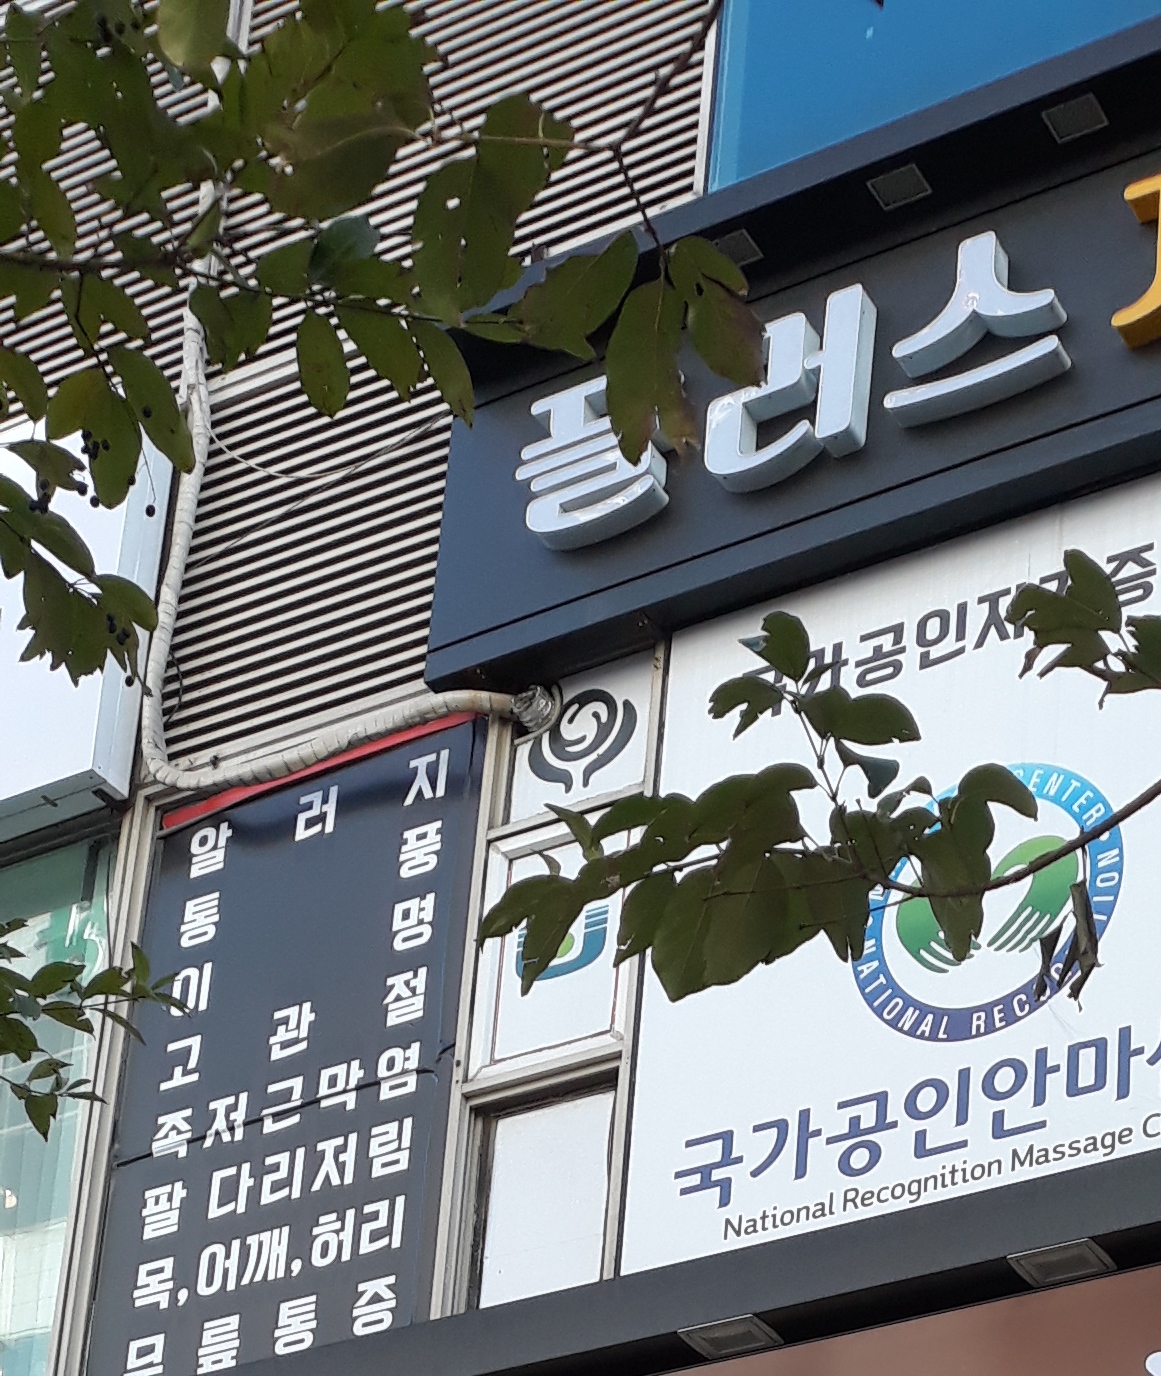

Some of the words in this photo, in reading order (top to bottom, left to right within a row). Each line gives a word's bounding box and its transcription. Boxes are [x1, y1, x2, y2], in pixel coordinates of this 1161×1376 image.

[151, 1042, 421, 1160] 족저근막염
[722, 1180, 836, 1242] National
[841, 1155, 1003, 1214] Recognition
[1009, 1125, 1134, 1183] Massage
